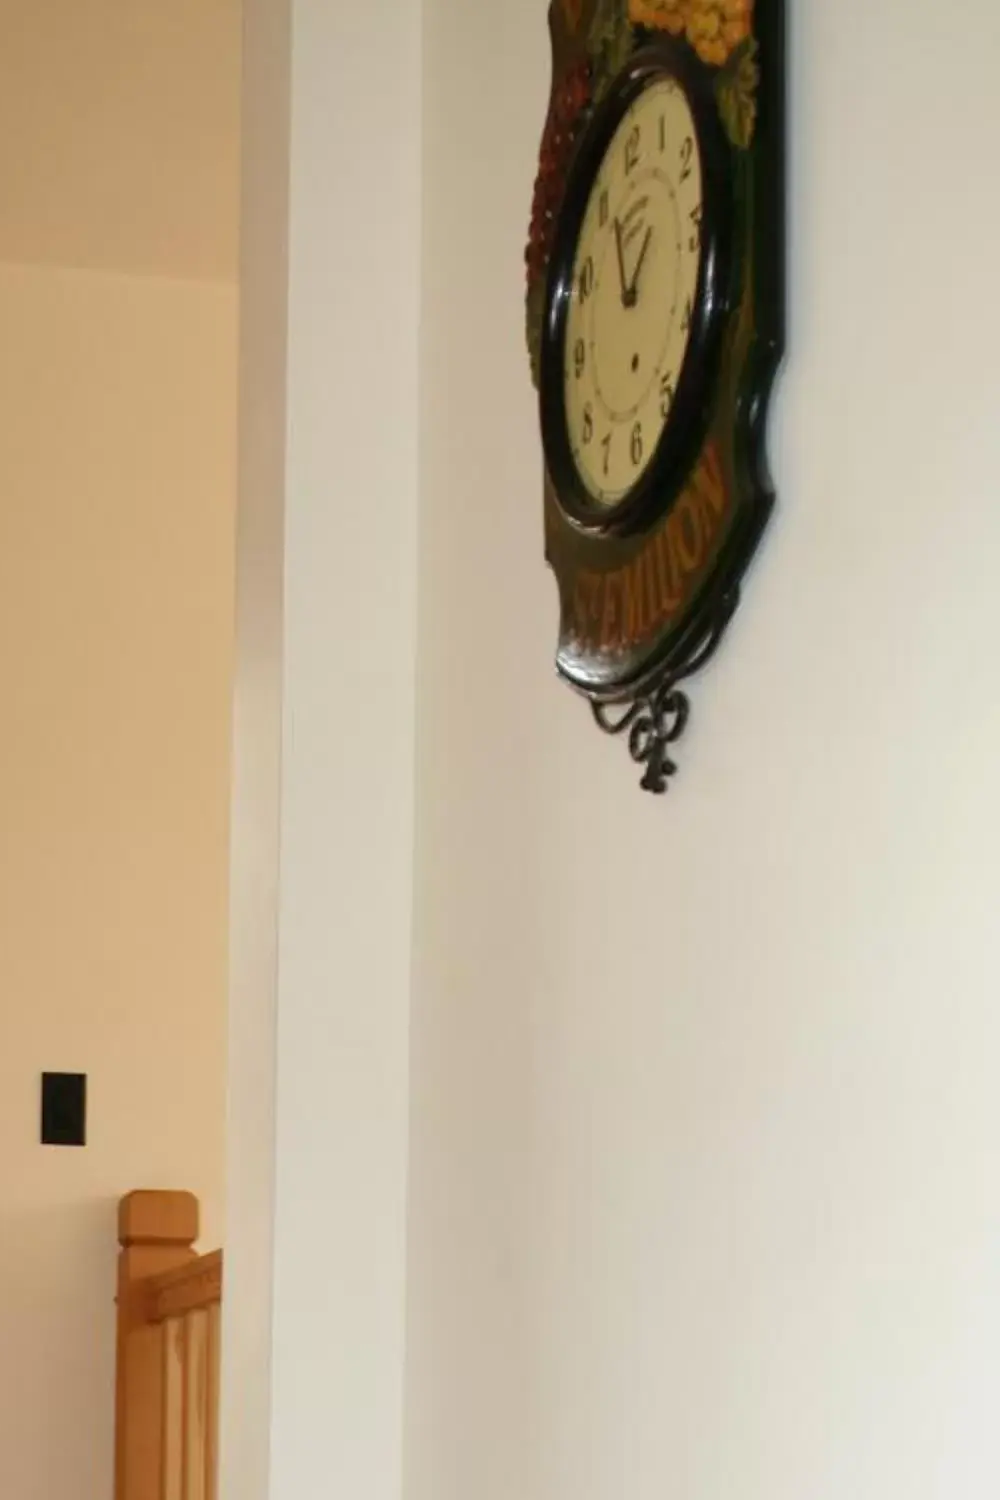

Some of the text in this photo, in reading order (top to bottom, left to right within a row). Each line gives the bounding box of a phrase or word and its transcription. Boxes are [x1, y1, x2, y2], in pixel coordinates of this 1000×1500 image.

[624, 124, 641, 177] 12
[658, 114, 666, 154] 1
[679, 135, 694, 183] 2
[578, 255, 595, 305] 10
[573, 338, 585, 380] 9
[581, 400, 595, 446] 8
[629, 420, 643, 466] 6
[601, 431, 612, 476] 7
